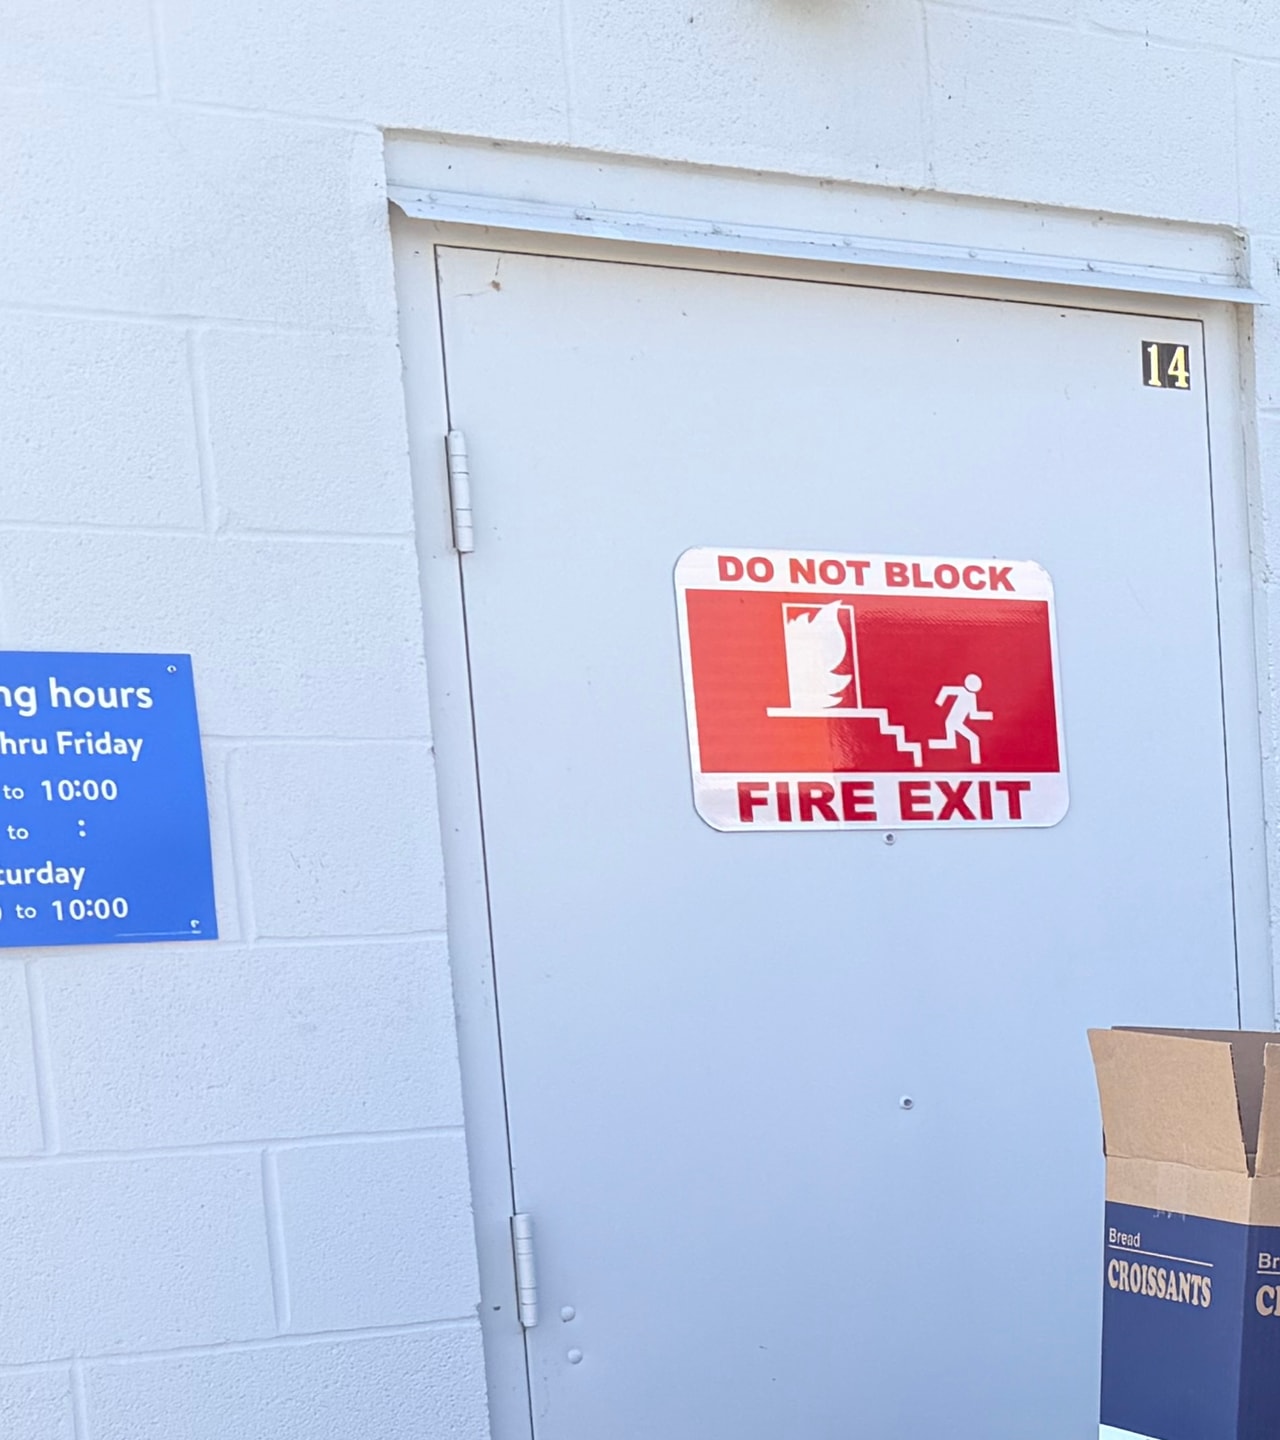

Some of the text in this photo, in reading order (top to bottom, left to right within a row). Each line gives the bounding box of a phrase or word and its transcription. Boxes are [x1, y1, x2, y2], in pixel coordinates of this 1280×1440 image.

[1147, 344, 1189, 388] 14
[718, 555, 1016, 592] DO NOT BLOCK
[49, 677, 153, 710] hours
[56, 731, 144, 762] Friday
[2, 779, 118, 801] to 10:00
[737, 781, 1031, 823] FIRE EXIT
[7, 823, 29, 840] to
[15, 897, 129, 921] to 10:00
[1108, 1227, 1141, 1249] Bread
[1108, 1257, 1212, 1309] CROISSANTS
